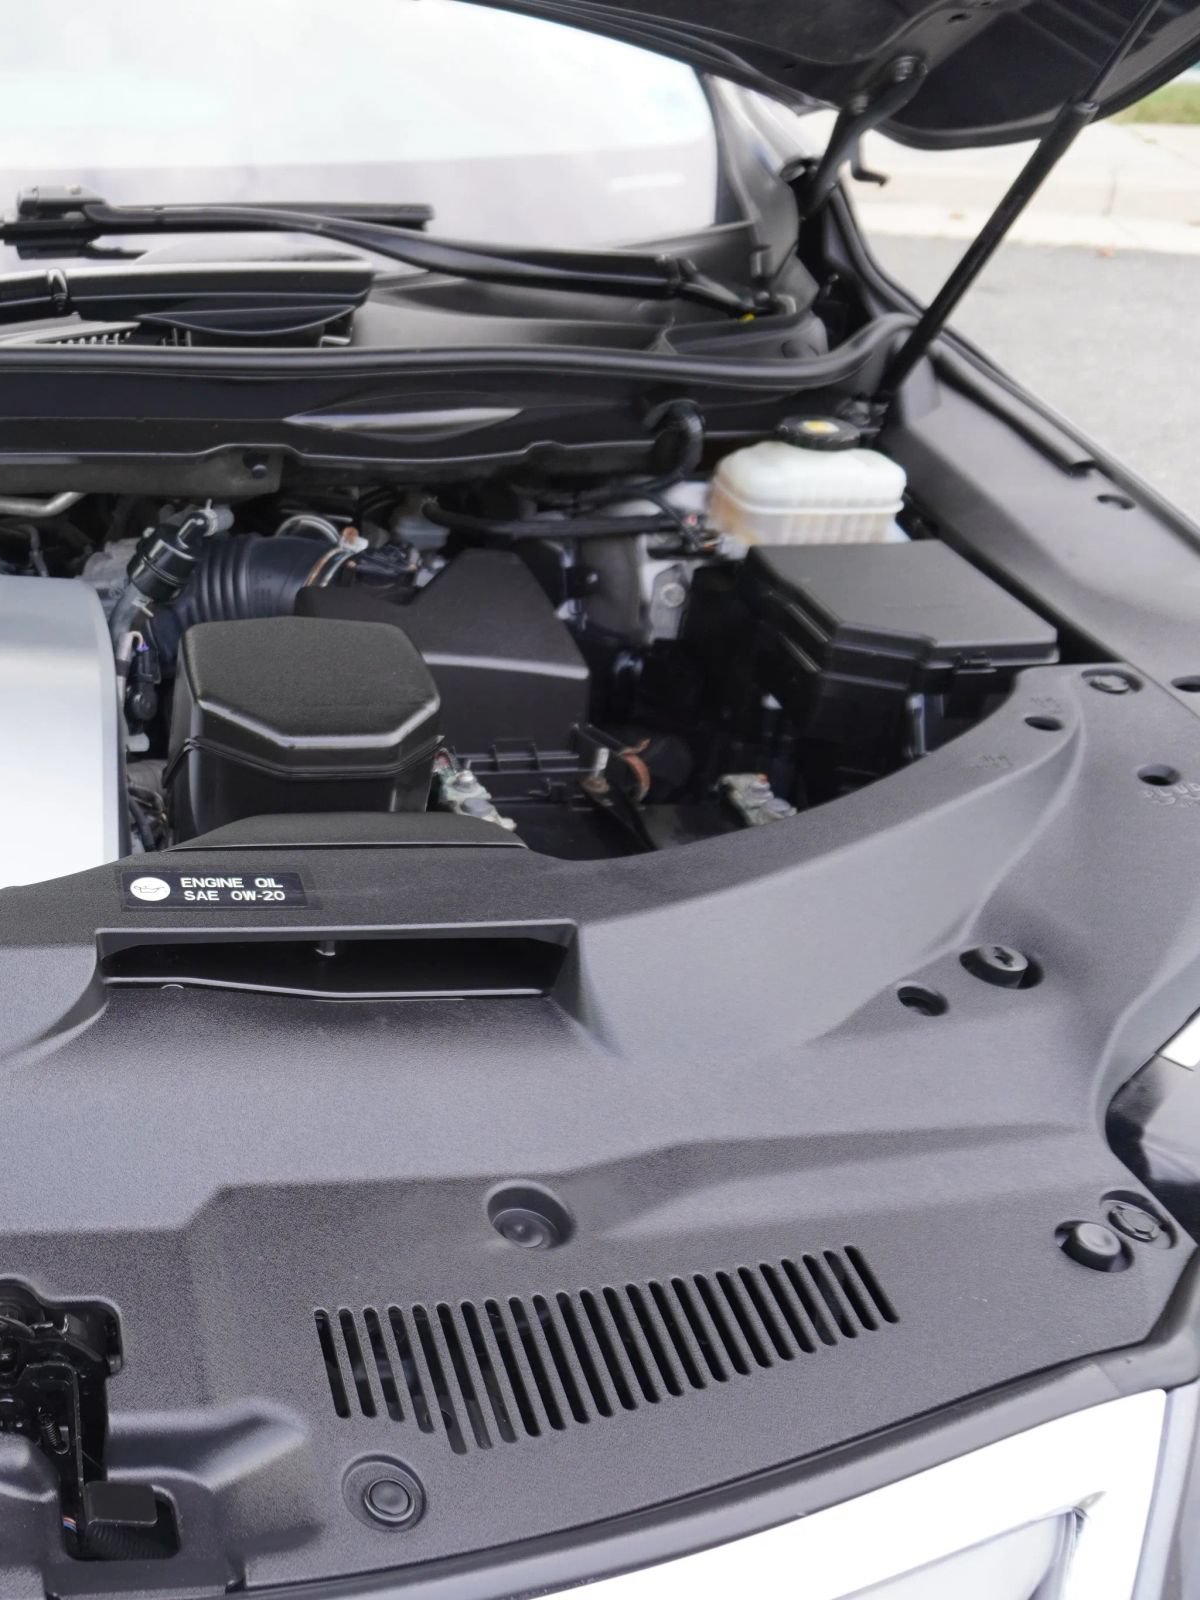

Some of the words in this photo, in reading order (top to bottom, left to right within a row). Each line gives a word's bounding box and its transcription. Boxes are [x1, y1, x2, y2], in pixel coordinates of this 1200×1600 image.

[180, 877, 245, 888] ENGINE
[254, 877, 284, 888] OIL
[184, 890, 220, 901] SAE
[230, 890, 286, 901] 0W-20
